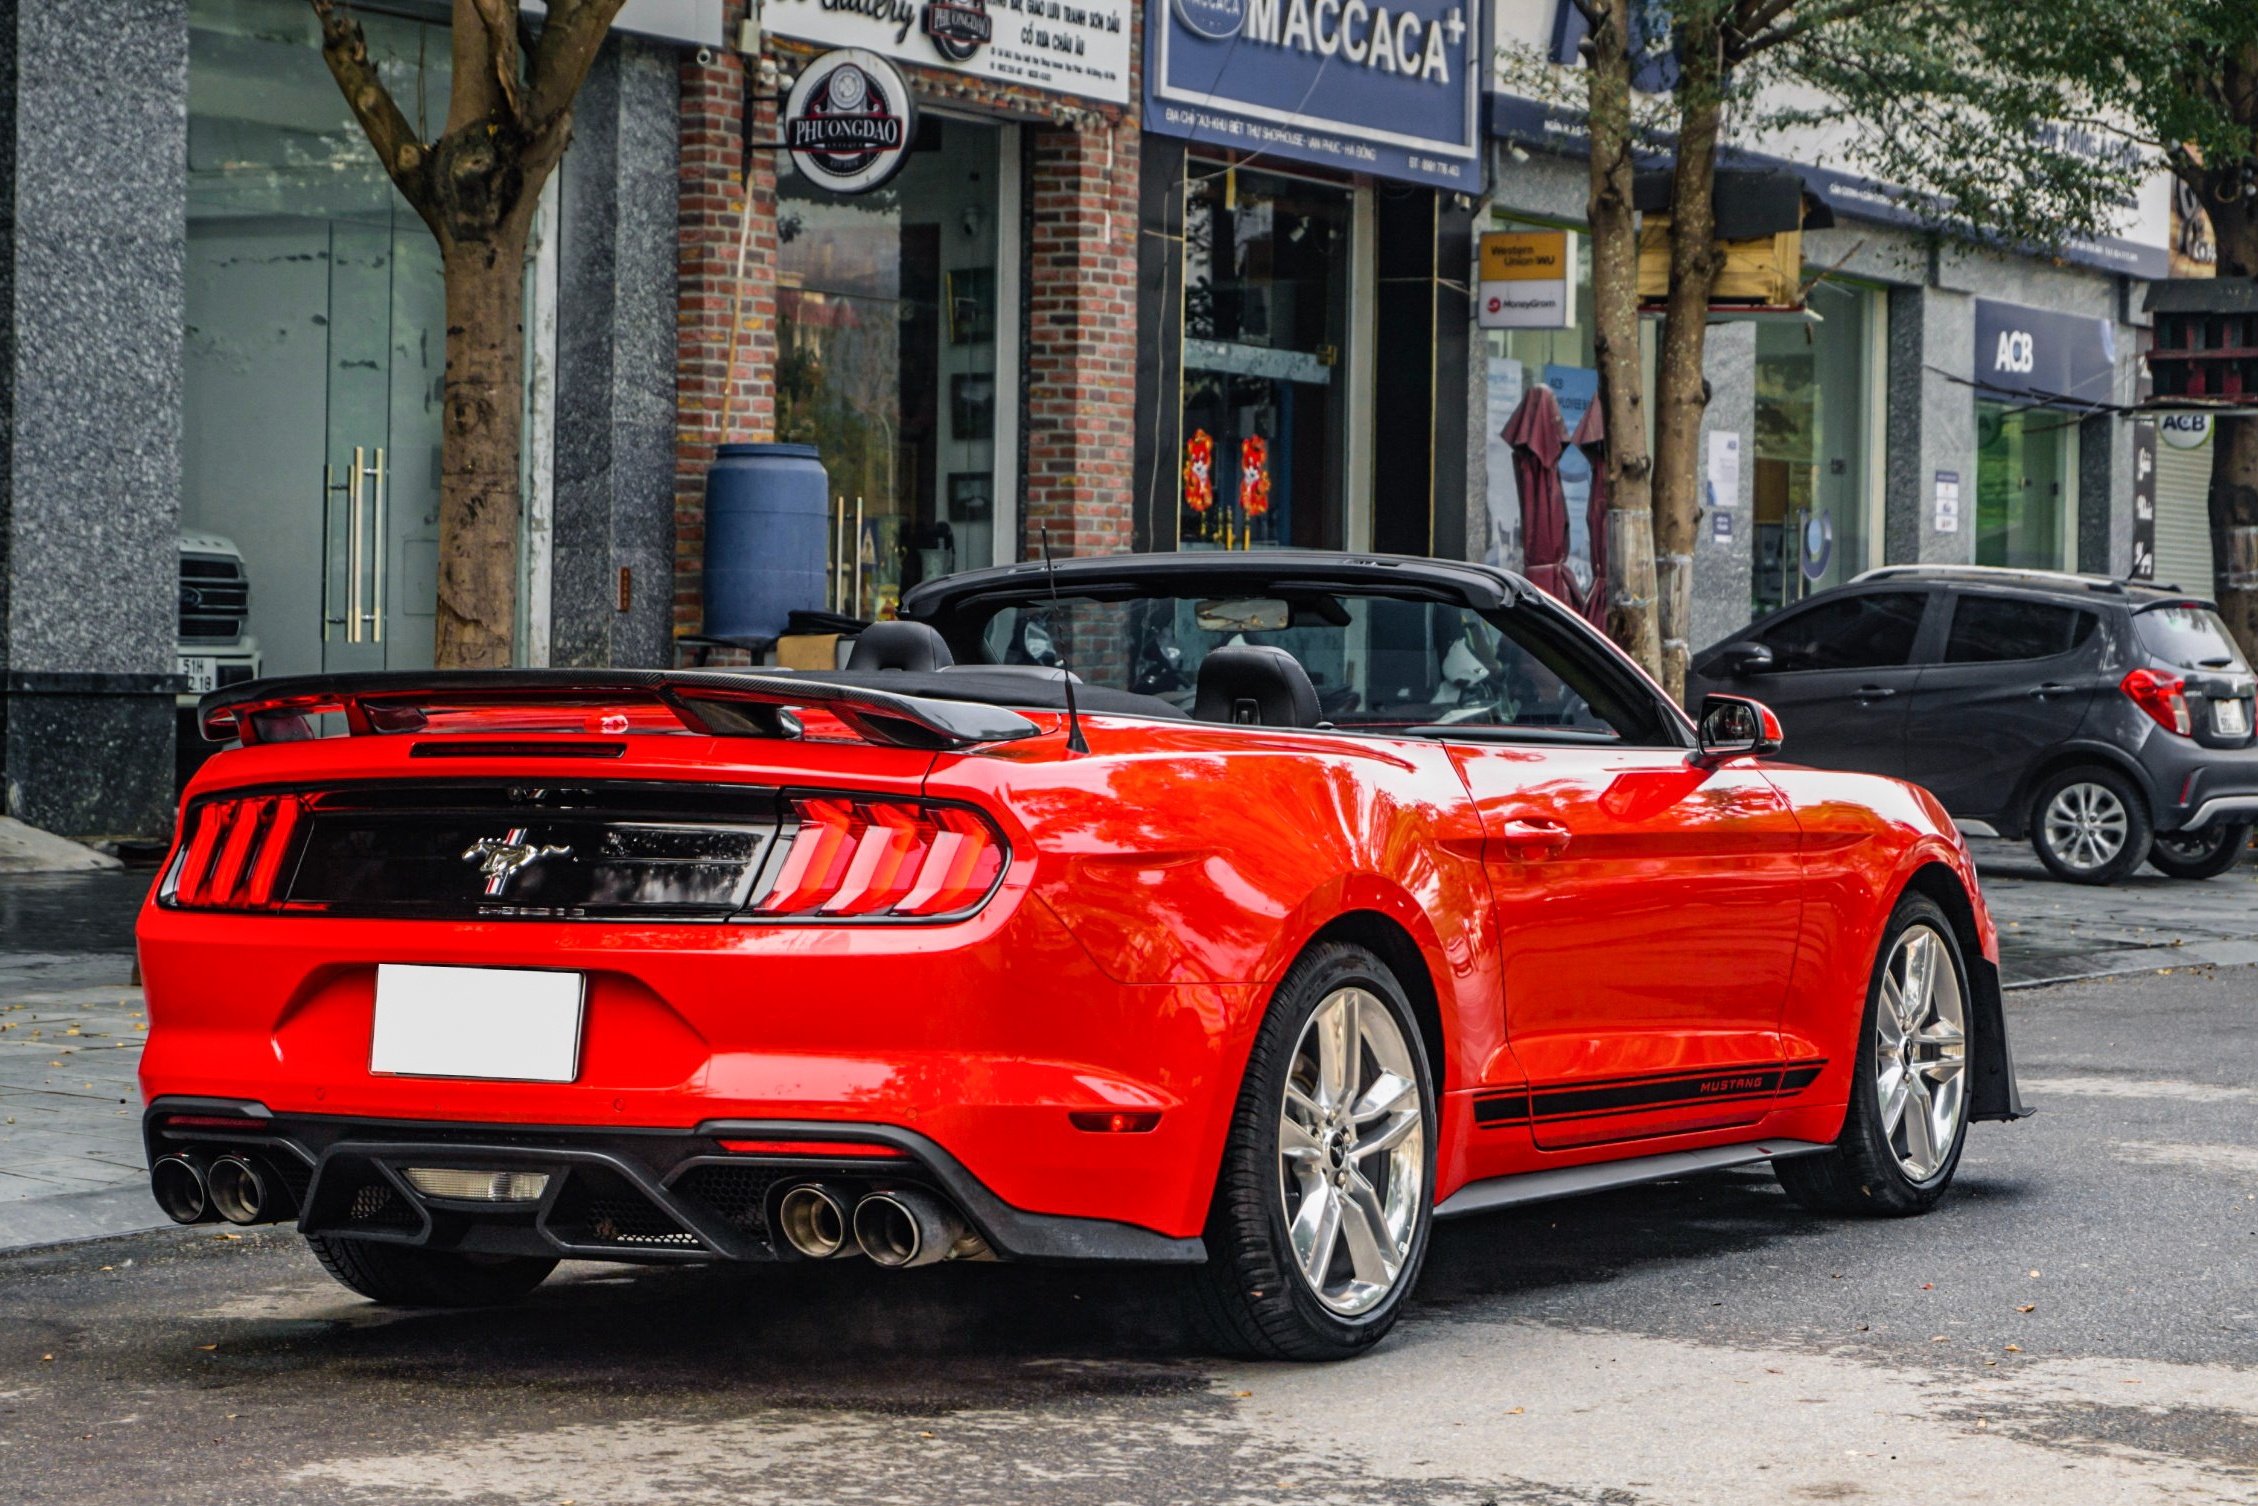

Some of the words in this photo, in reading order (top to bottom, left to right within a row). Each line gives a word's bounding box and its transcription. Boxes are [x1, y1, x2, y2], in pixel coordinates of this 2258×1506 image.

[1063, 5, 1085, 26] TRANH
[796, 119, 898, 146] PHUONGDAO
[1491, 245, 1535, 256] Western
[1504, 256, 1534, 267] Union
[1502, 299, 1556, 310] MoneyGram
[1995, 331, 2034, 373] ACB
[2162, 414, 2206, 431] ACB
[183, 659, 203, 674] 51H
[1700, 1076, 1763, 1093] MUSTANG
